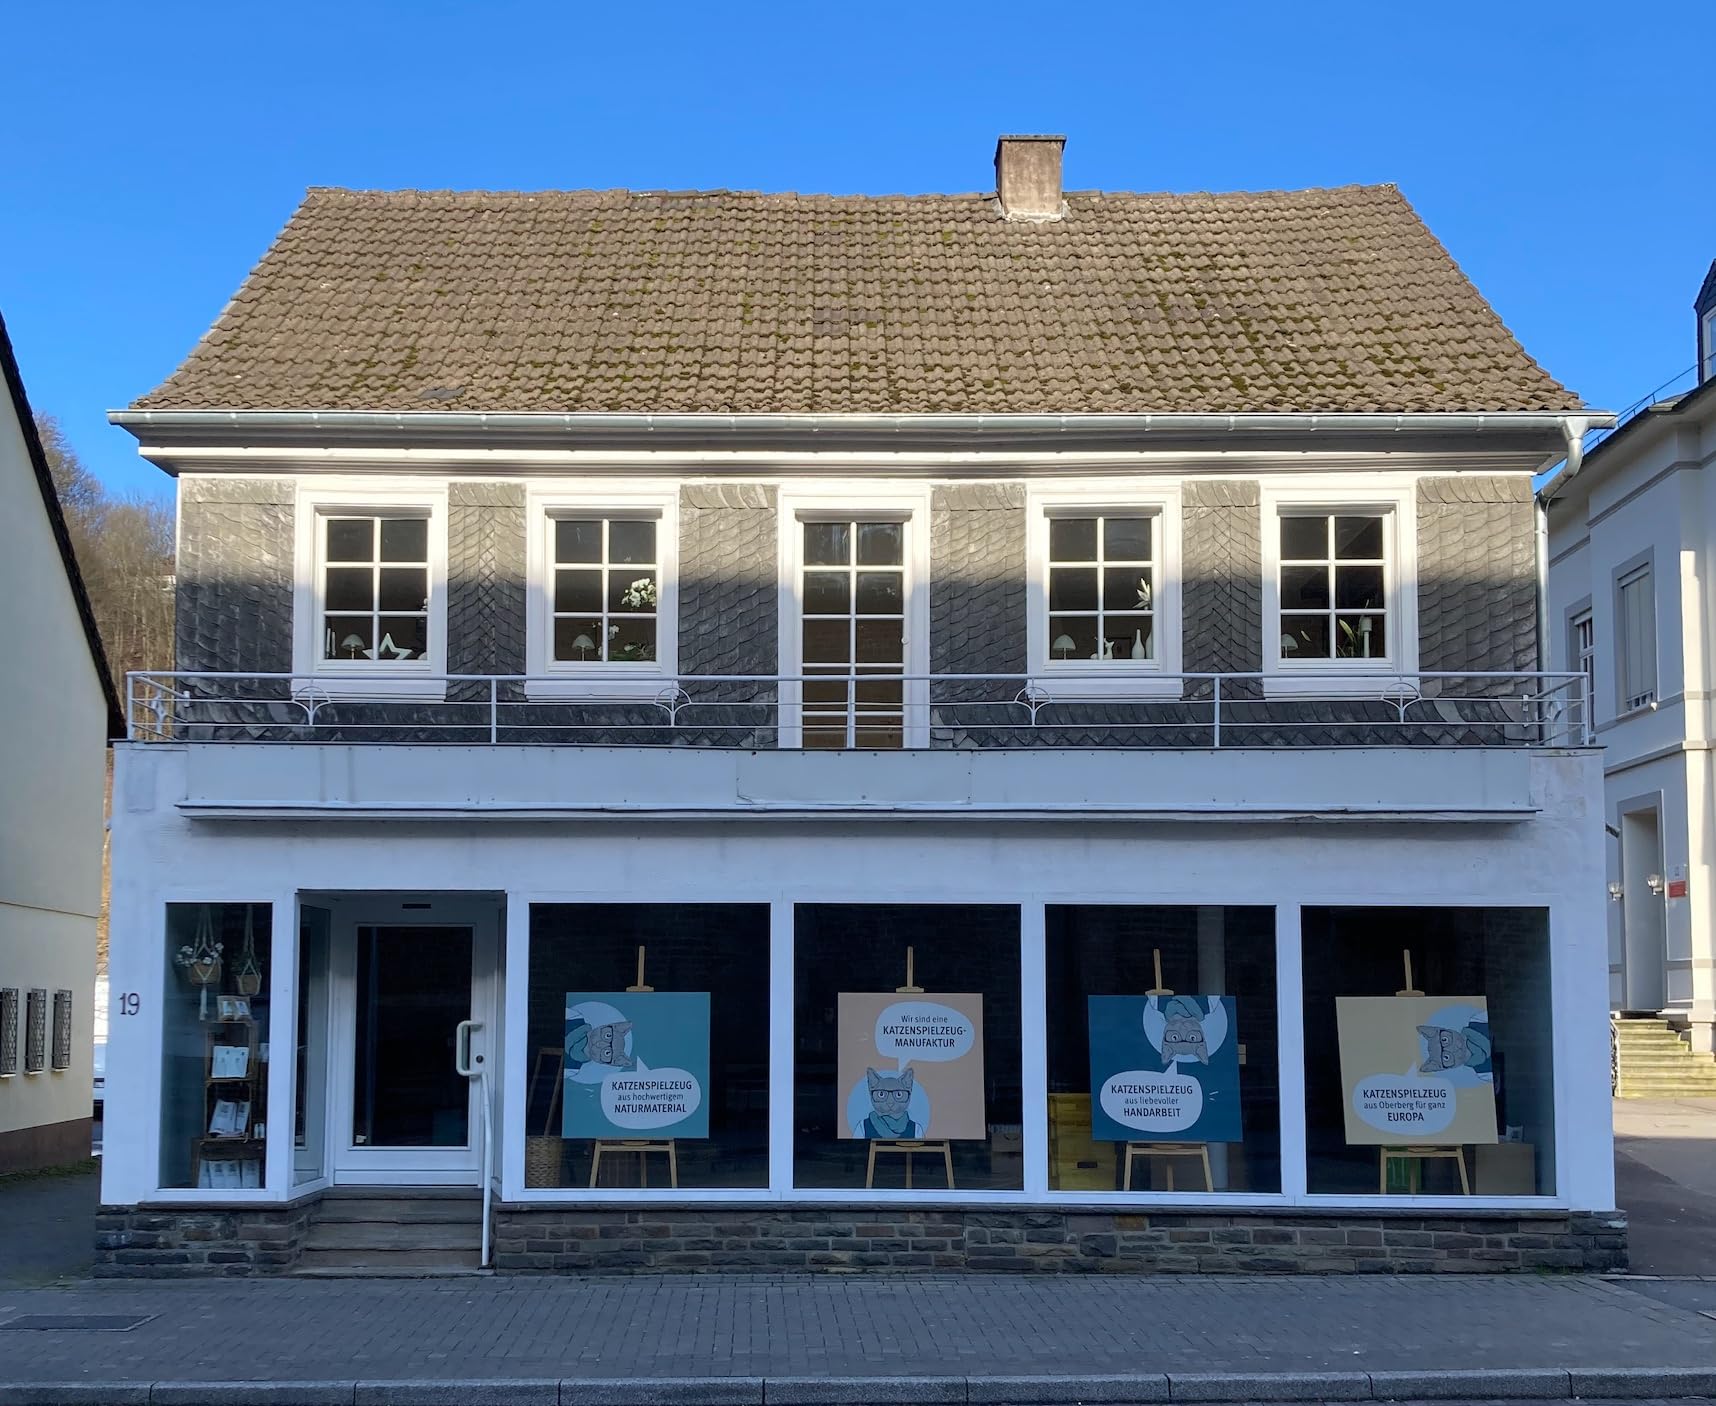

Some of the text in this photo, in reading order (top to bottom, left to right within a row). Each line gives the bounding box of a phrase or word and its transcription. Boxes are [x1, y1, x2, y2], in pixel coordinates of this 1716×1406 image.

[119, 992, 141, 1016] 19
[901, 1015, 948, 1024] Wir sind eine
[883, 1025, 967, 1036] KATZENSPIELZEUG-
[894, 1038, 955, 1048] MANUFAKTUR
[611, 1080, 692, 1091] KATZENSPIELZEUG
[1111, 1084, 1193, 1095] KATZENSPIELZEUG
[632, 1092, 684, 1102] hochwertigem
[1363, 1089, 1447, 1099] KATZENSPIELZEUG
[1139, 1096, 1179, 1105] liebevoller
[1363, 1100, 1446, 1112] aus Oberberg für ganz
[614, 1103, 687, 1114] NATURMATERIAL
[1123, 1107, 1181, 1118] HANDARBEIT
[1387, 1112, 1424, 1122] EUROPA
